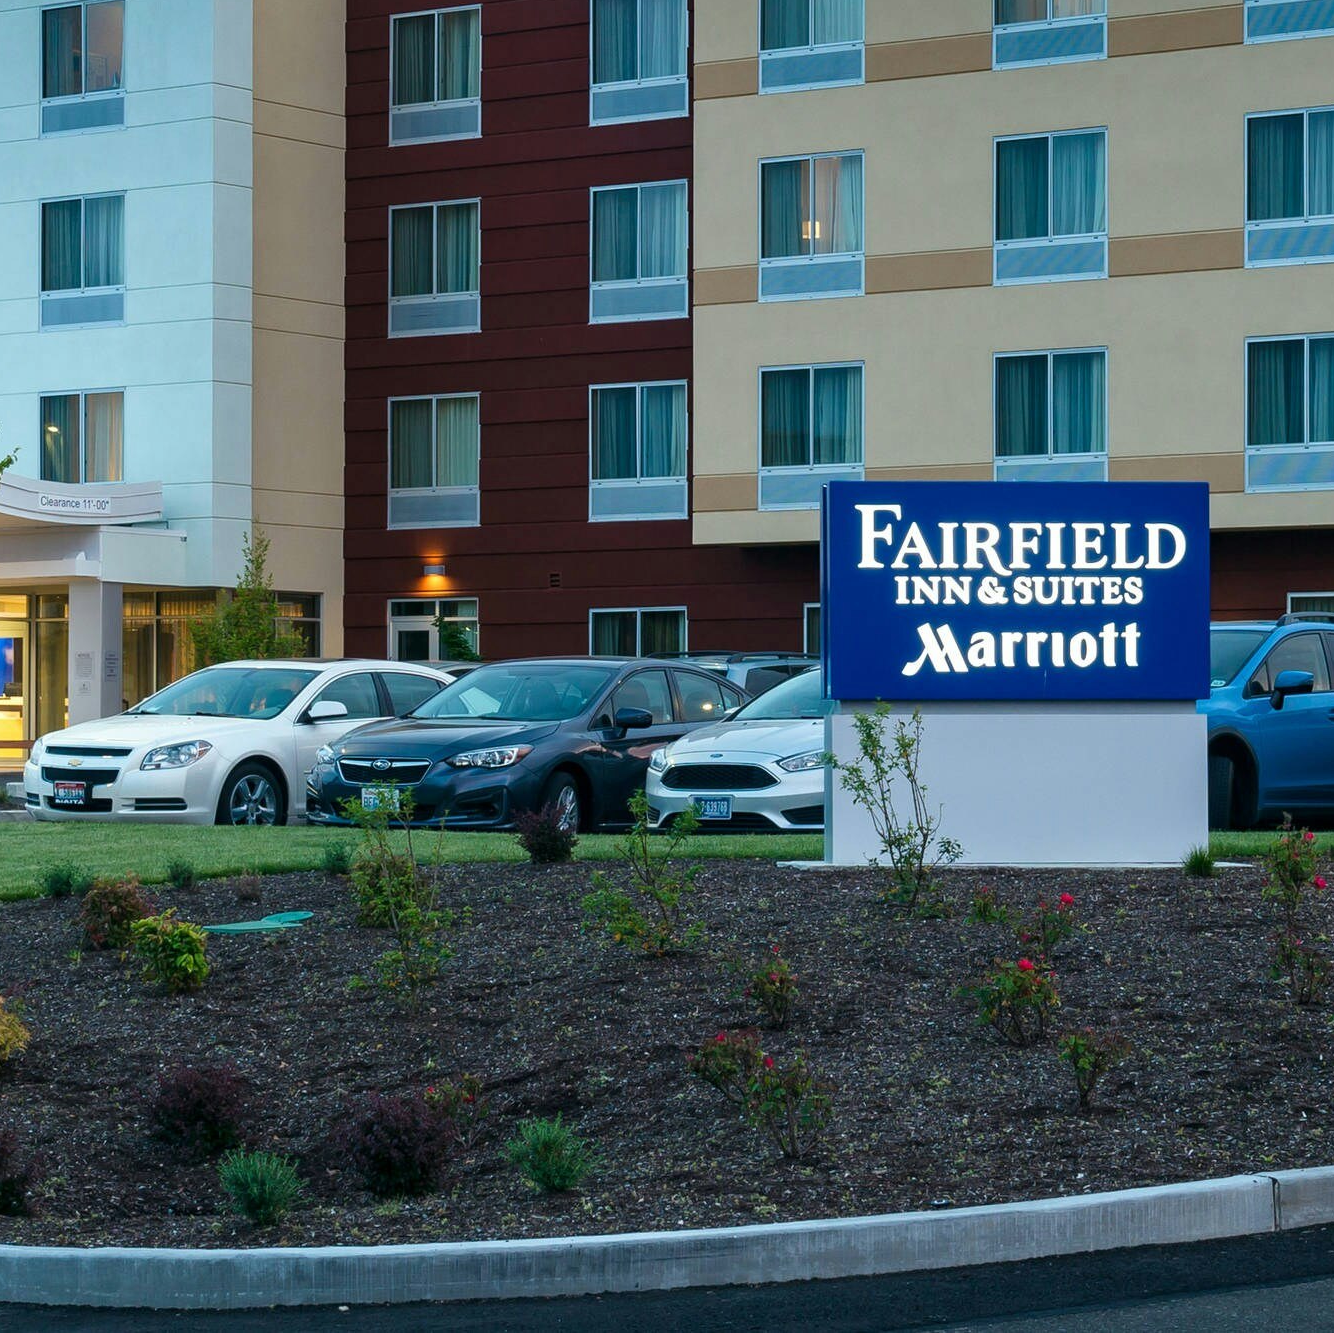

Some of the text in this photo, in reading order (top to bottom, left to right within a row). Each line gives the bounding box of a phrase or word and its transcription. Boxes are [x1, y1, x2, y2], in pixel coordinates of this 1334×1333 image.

[40, 495, 81, 508] Clearance
[854, 504, 1187, 577] FAIRFIELD
[901, 622, 1142, 676] Marriott
